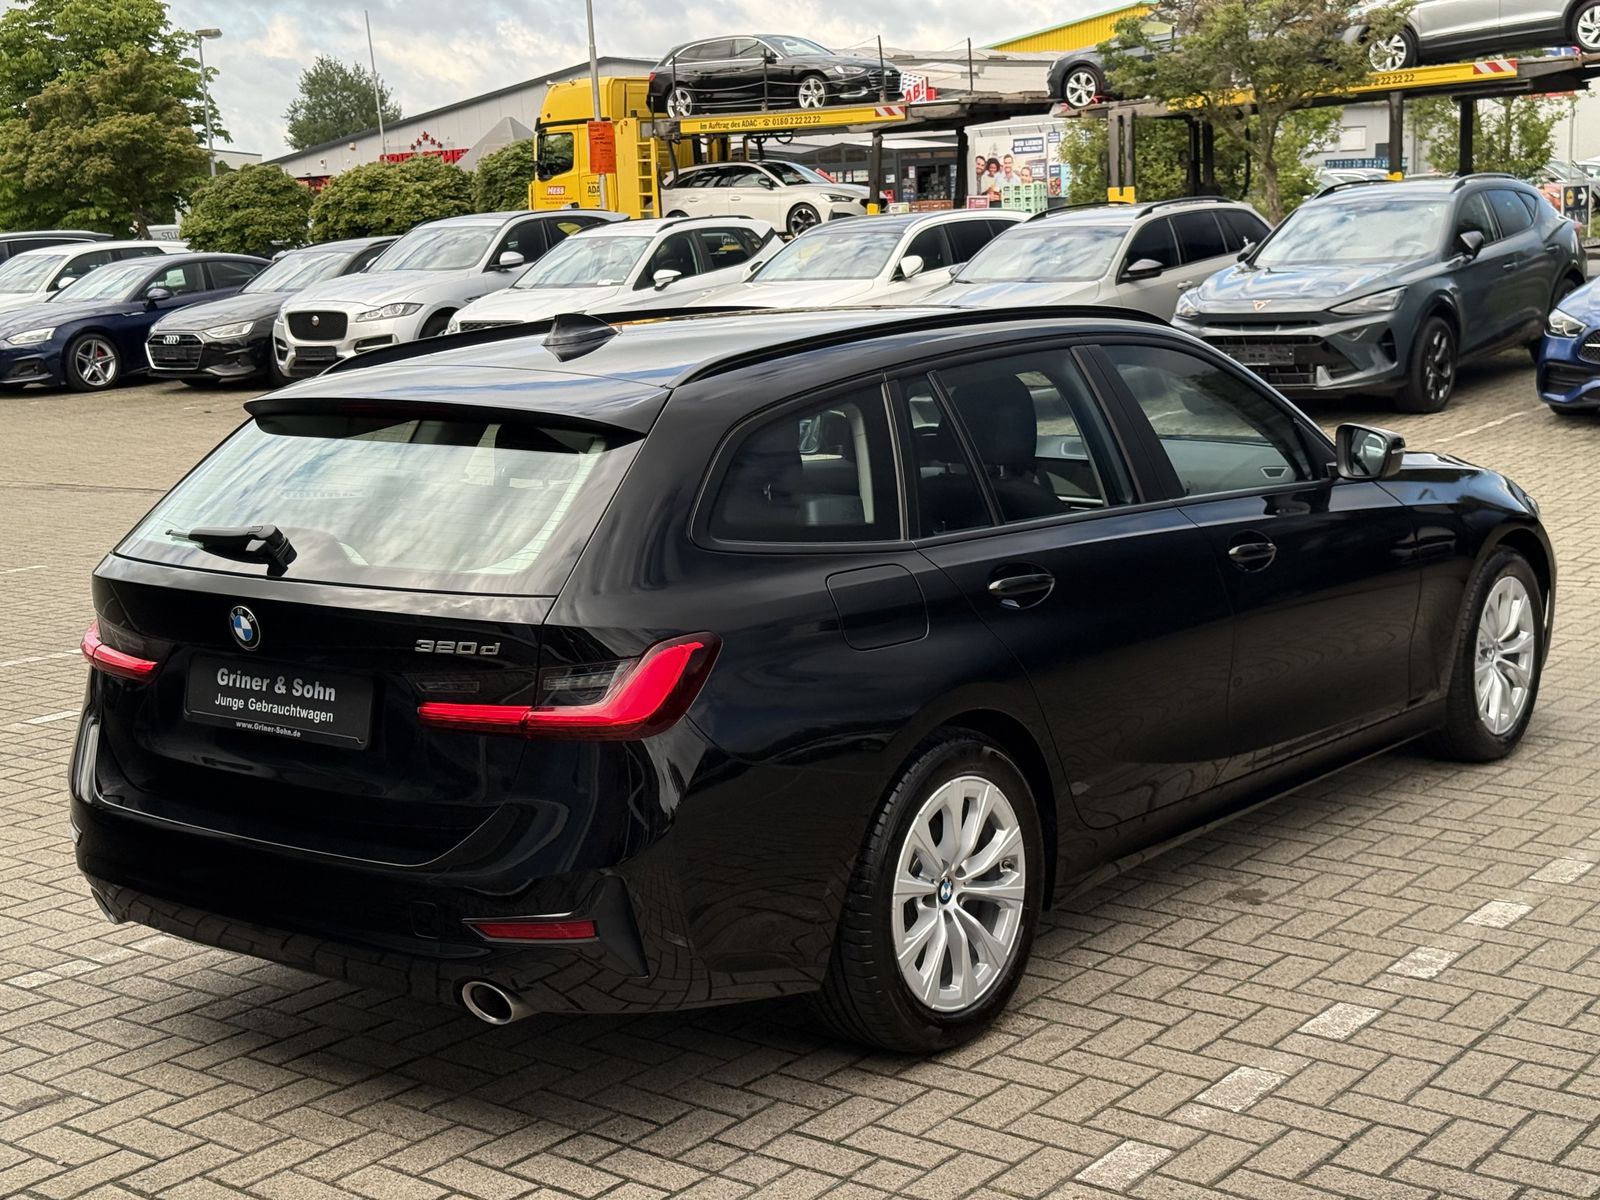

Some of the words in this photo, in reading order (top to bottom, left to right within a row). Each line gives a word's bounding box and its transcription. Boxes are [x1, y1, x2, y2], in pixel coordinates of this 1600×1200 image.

[1380, 77, 1391, 85] 22
[1393, 75, 1403, 84] 22
[1405, 74, 1415, 82] 22
[708, 121, 730, 131] Auftrag
[730, 120, 741, 129] des
[741, 119, 758, 128] ADAC
[587, 185, 600, 194] ADA
[161, 231, 179, 240] STU
[414, 639, 501, 655] 320d
[216, 667, 271, 692] Griner
[274, 675, 287, 695] &
[292, 678, 336, 702] Sohn
[214, 693, 245, 711] Junge
[248, 698, 334, 724] Gebrauchtwagen
[235, 720, 302, 739] www.Griner-Sohn.de
